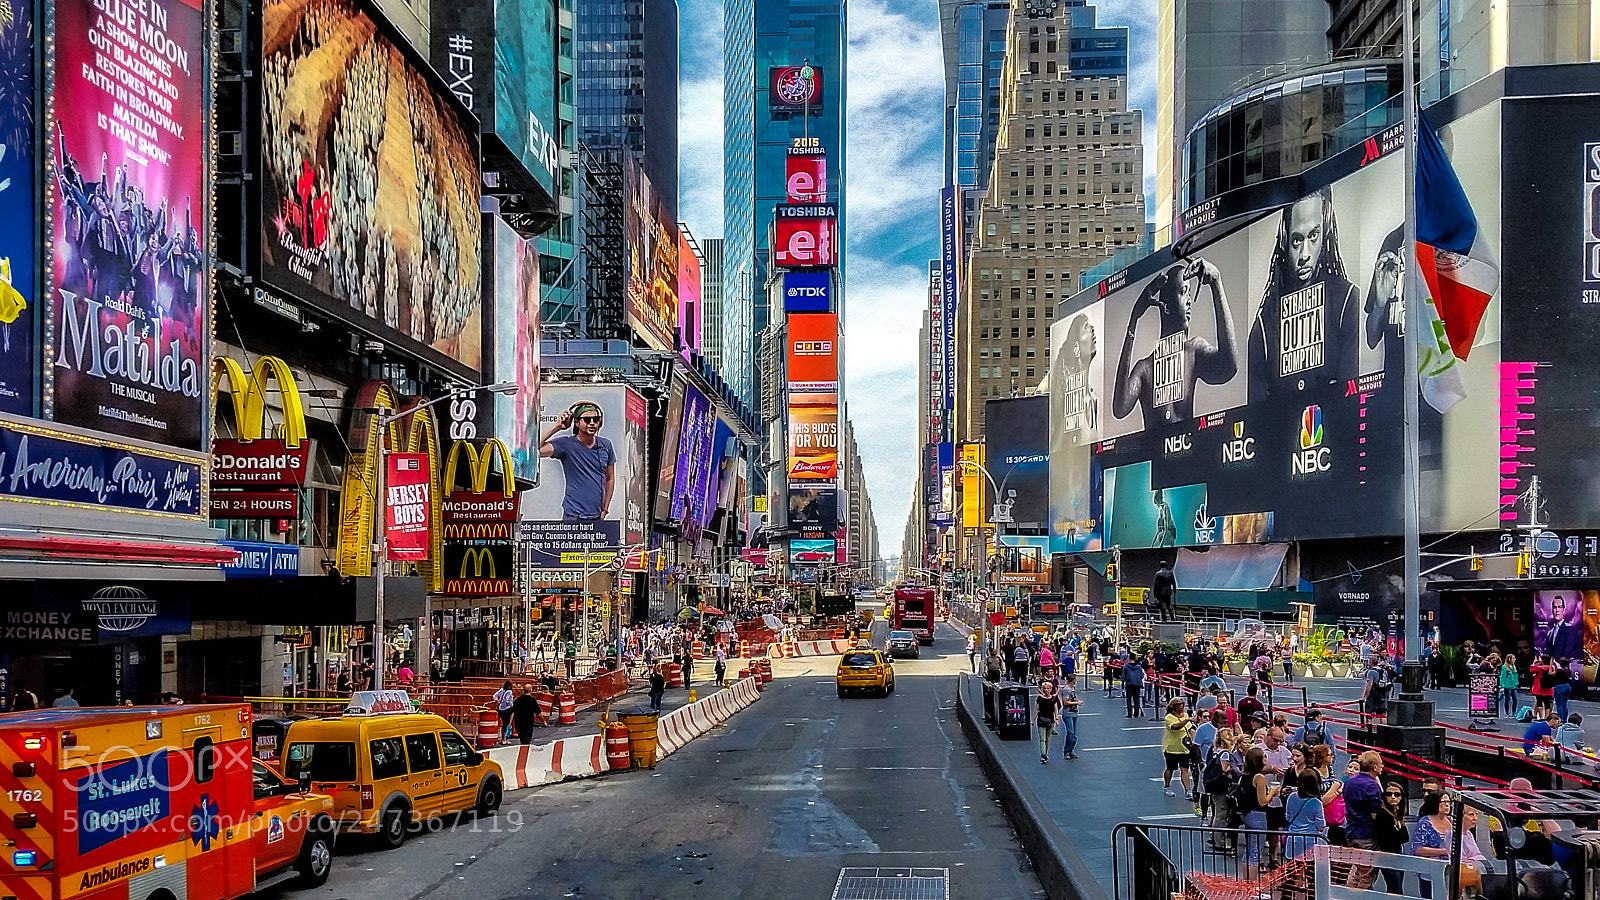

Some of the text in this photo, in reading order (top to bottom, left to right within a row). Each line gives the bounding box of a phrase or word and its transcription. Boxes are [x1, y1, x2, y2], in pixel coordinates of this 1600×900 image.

[151, 0, 167, 32] IN
[96, 14, 172, 78] A SHOW COMES
[140, 17, 190, 77] MOON,
[88, 29, 179, 99] OUT BLAZING AND
[96, 51, 173, 115] RESTORES YOUR
[82, 62, 185, 141] FAITH IN BROADWAY.
[97, 112, 108, 130] IS
[108, 118, 137, 147] THAT
[113, 102, 159, 142] MATILDA
[786, 147, 826, 155] TOSHIBA
[793, 137, 820, 148] 2015
[779, 205, 836, 217] TOSHIBA
[1184, 198, 1222, 221] MARRIOTT
[1184, 210, 1217, 231] MARQUIS
[281, 231, 323, 267] Beautiful
[288, 254, 313, 283] China
[797, 286, 827, 298] TDK
[1108, 279, 1127, 292] MARQUIS
[104, 295, 147, 321] Roald Dahl's
[944, 196, 955, 399] Watch more at yahoo.com/katiecouric
[1282, 284, 1324, 319] STRAIGHT
[54, 288, 201, 398] Matilda
[1282, 310, 1323, 353] OUTTA
[1154, 331, 1185, 361] STRAIGHT
[1155, 352, 1184, 388] OUTTA
[1282, 343, 1323, 376] COMPTON
[1358, 381, 1383, 392] MARQUIS
[1359, 372, 1386, 384] MARRIOTT
[110, 381, 157, 405] THE MUSICAL
[1154, 382, 1184, 406] COMPTON
[98, 404, 168, 431] MatildaTheMusical.com
[790, 422, 837, 434] THIS BUD'S
[789, 433, 837, 448] FOR YOU
[1164, 432, 1193, 455] NBC
[1222, 436, 1256, 463] NBC
[10, 434, 108, 504] American
[112, 456, 158, 509] Paris
[794, 463, 831, 471] Budweiser
[1292, 446, 1332, 475] NBC
[210, 471, 282, 480] Restaurant
[232, 500, 247, 509] 24
[251, 500, 293, 510] HOURS
[386, 482, 430, 507] JERSEY
[442, 500, 515, 512] McDonald's
[393, 503, 426, 526] BOYS
[453, 511, 502, 520] Restaurant
[532, 532, 545, 541] Gov.
[546, 532, 567, 541] Cuomo
[567, 532, 574, 540] is
[574, 532, 595, 542] raising
[596, 532, 607, 540] the
[541, 523, 572, 532] education
[580, 523, 594, 532] hard
[1195, 529, 1215, 544] NBC
[552, 541, 560, 549] 15
[561, 541, 582, 549] dollars
[591, 541, 609, 549] hour?
[224, 551, 298, 570] ONEY ATM
[1338, 592, 1370, 600] VORNADO
[7, 611, 73, 625] MONEY
[113, 602, 158, 615] EXCHANGE
[114, 646, 123, 686] MONEY
[194, 714, 212, 726] 1762
[256, 735, 278, 746] JERSEY
[6, 789, 43, 802] 1762
[89, 773, 156, 802] St. Luke's
[89, 797, 162, 832] Roosevelt
[79, 856, 151, 892] Ambulance
